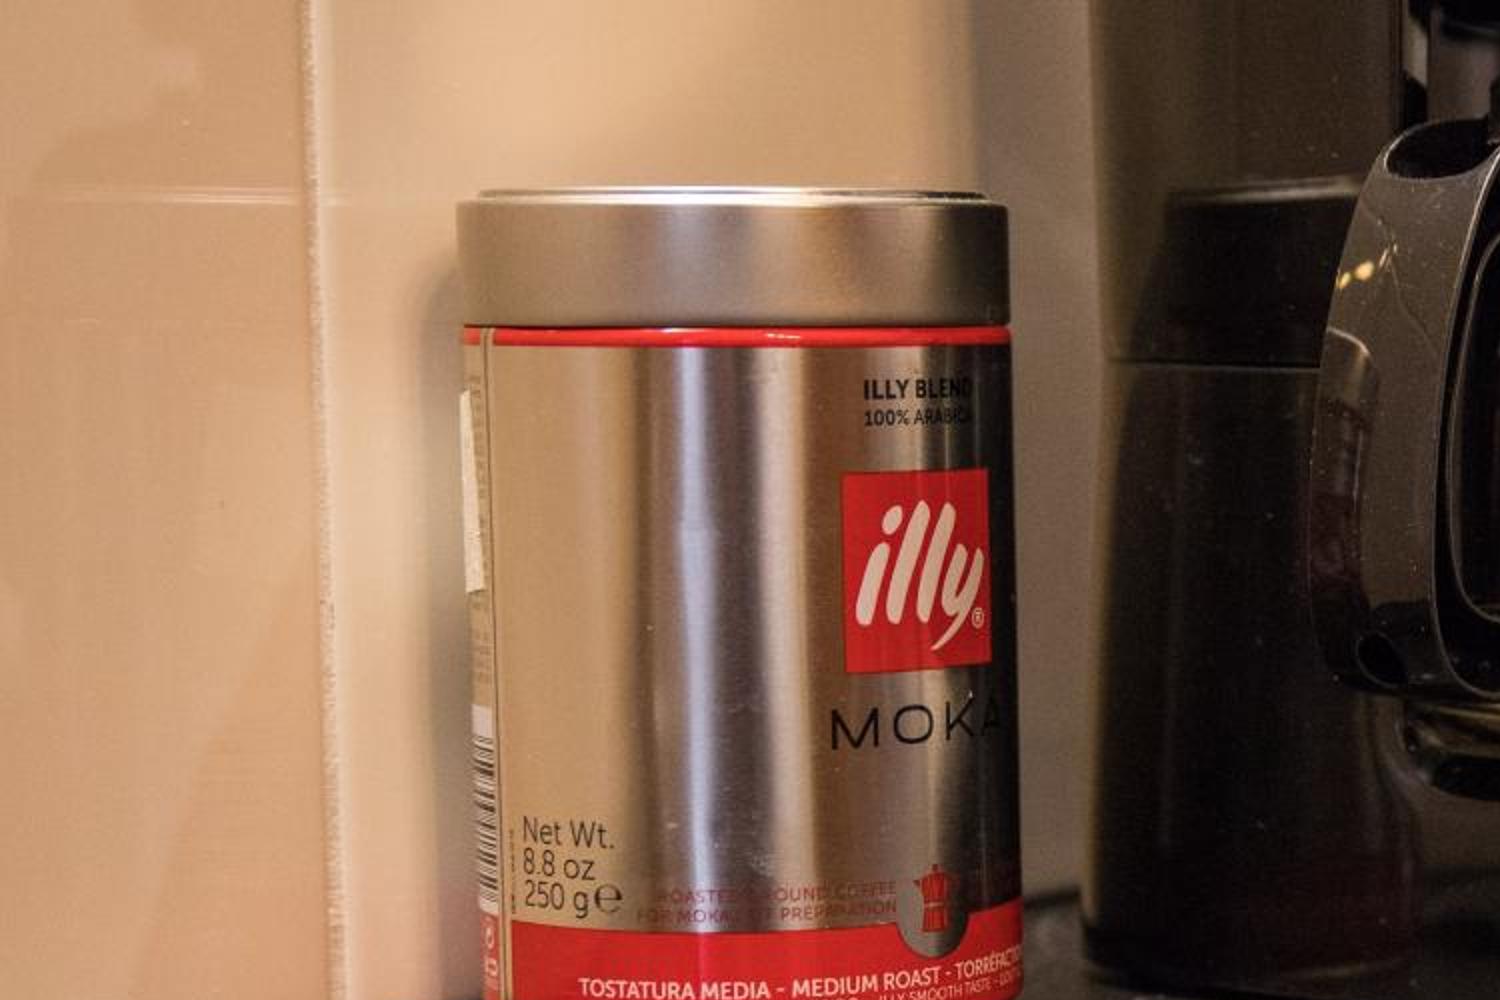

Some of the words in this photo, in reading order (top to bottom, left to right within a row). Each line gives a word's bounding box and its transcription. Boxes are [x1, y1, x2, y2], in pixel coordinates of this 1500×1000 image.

[864, 379, 909, 400] ILLY
[864, 408, 909, 426] 100%
[523, 816, 562, 846] Net
[569, 819, 615, 849] Wt.
[523, 847, 556, 877] 8.8
[563, 859, 596, 880] oz
[525, 879, 565, 911] 250
[578, 978, 696, 1000] TOSTATURA
[701, 980, 771, 1000] MEDIA
[792, 975, 878, 998] MEDIUM
[883, 966, 941, 991] ROAST
